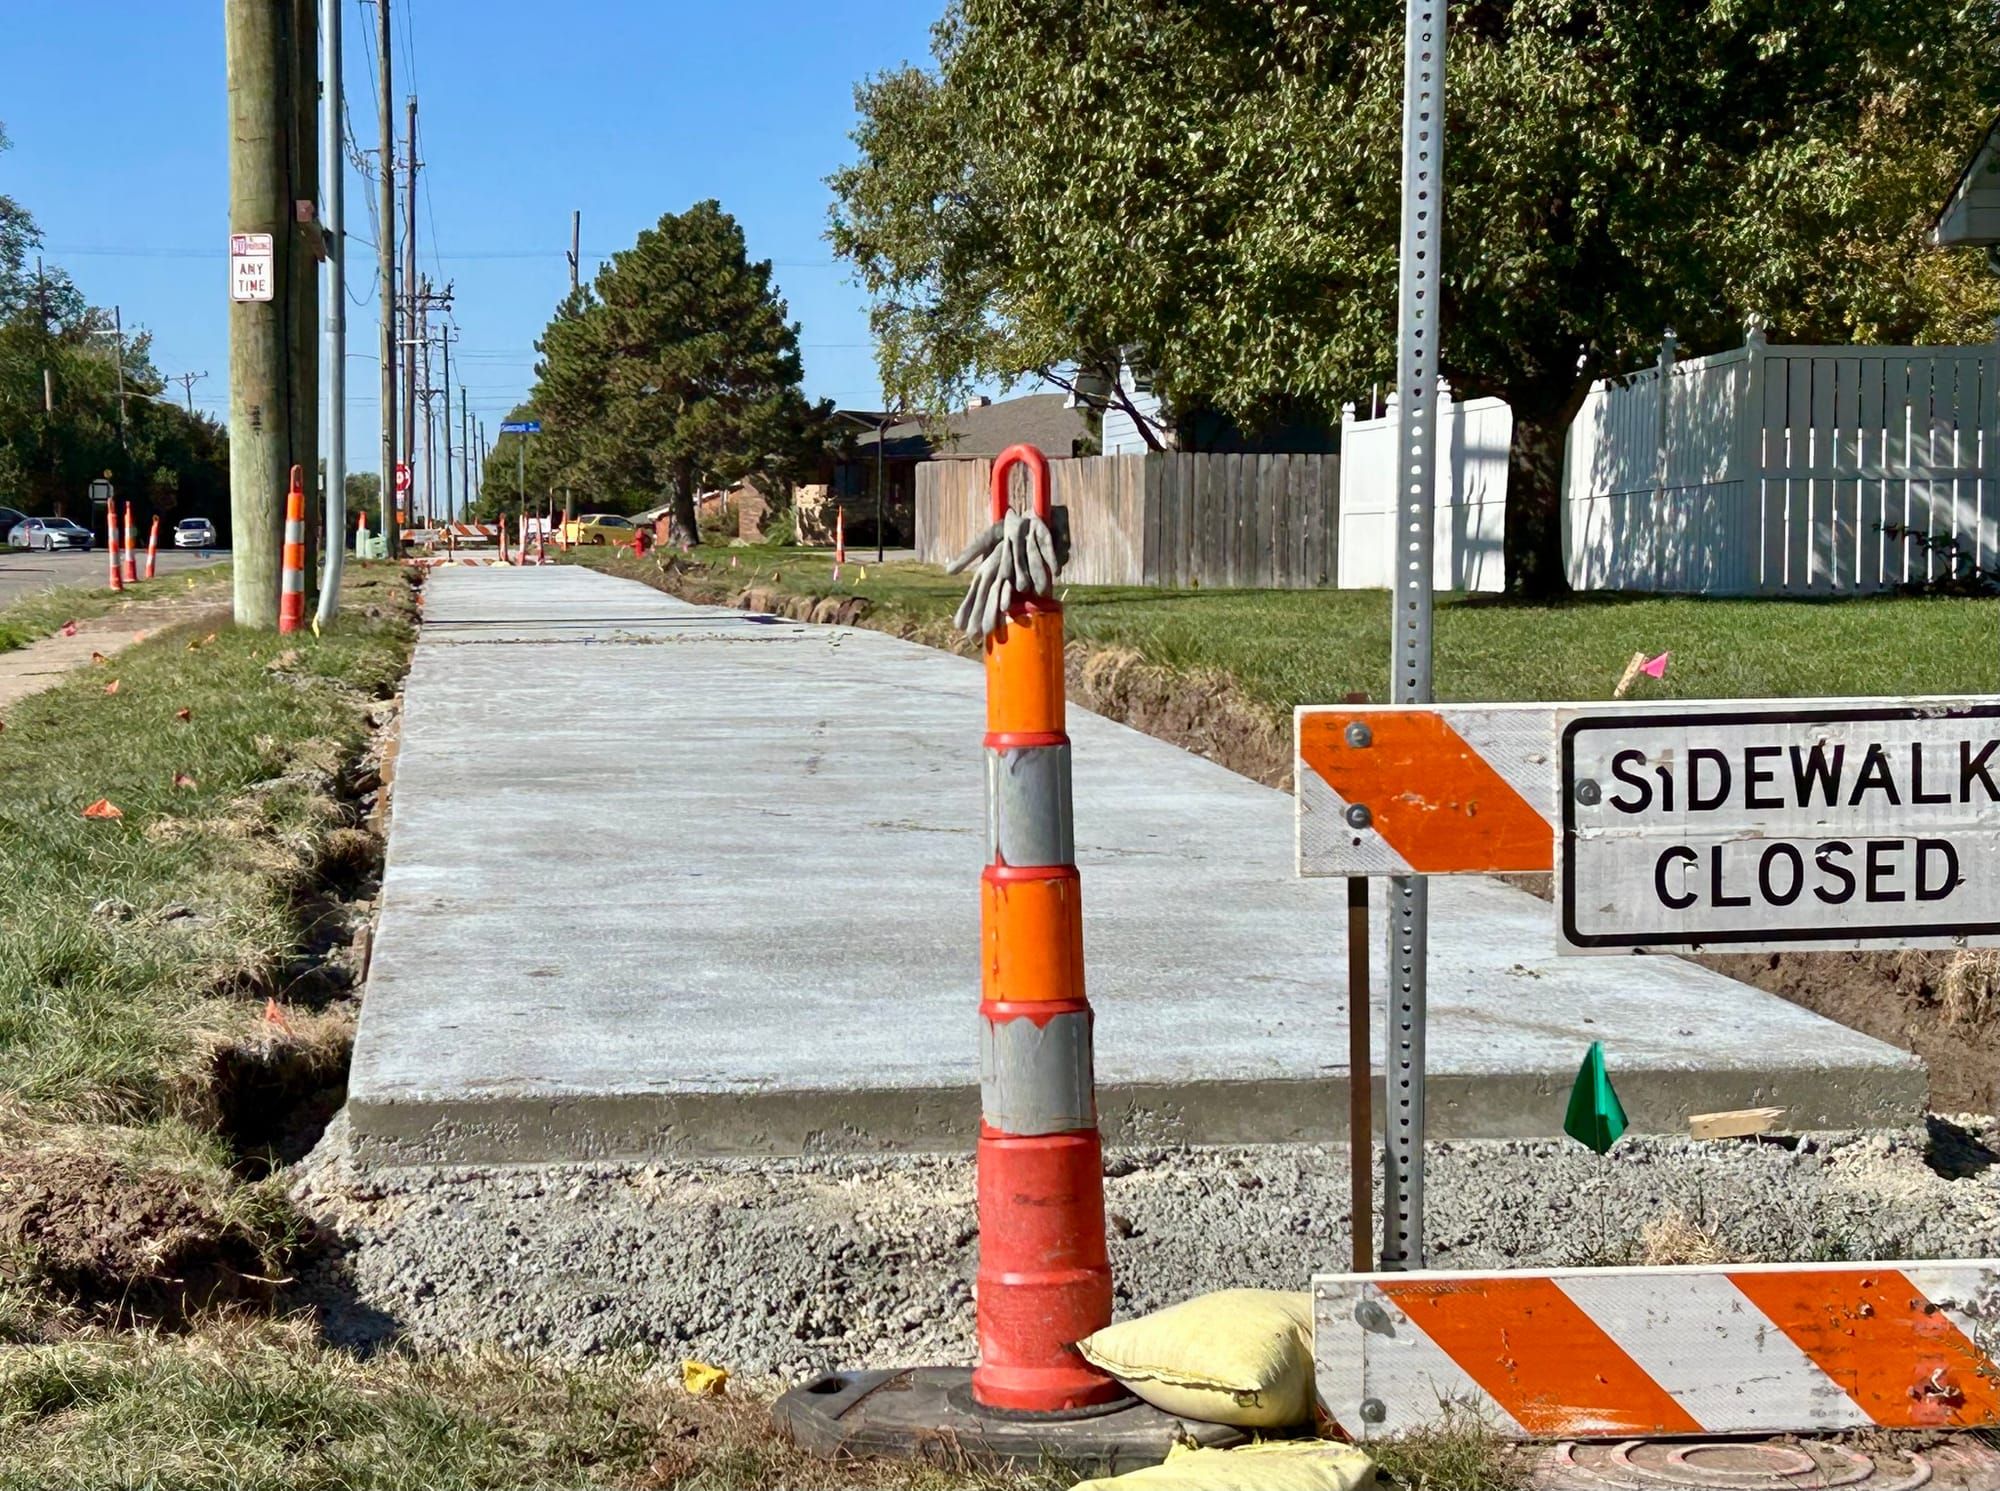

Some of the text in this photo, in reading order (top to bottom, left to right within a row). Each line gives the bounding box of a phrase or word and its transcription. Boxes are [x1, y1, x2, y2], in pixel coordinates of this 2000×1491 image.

[238, 280, 266, 292] TIME
[240, 263, 264, 275] ANY
[1609, 740, 2000, 813] SIDEWALK
[1654, 839, 1960, 910] CLOSED
